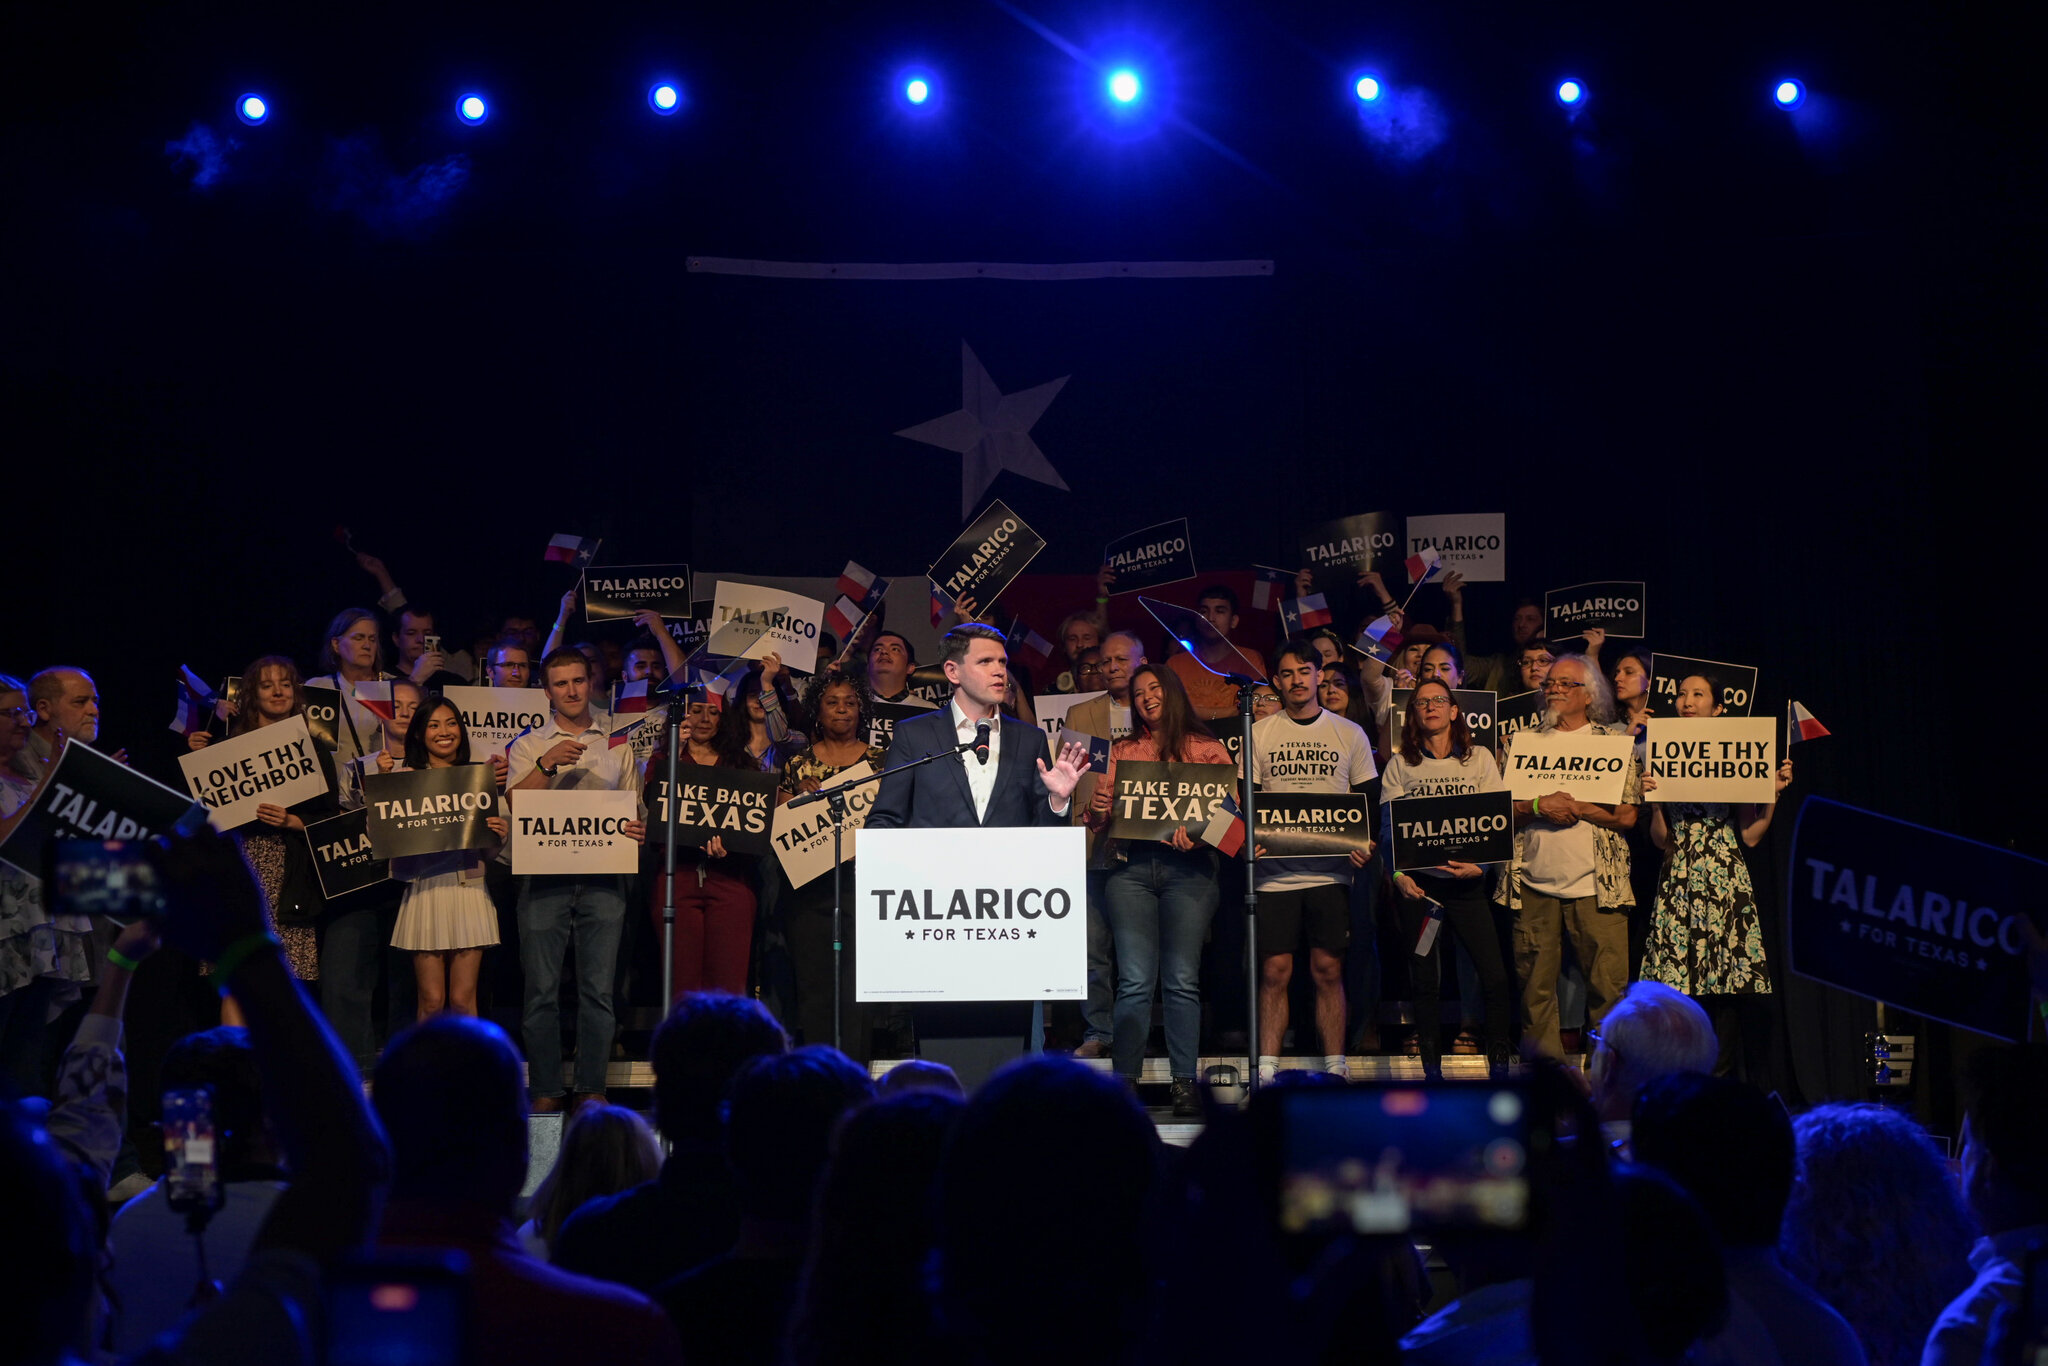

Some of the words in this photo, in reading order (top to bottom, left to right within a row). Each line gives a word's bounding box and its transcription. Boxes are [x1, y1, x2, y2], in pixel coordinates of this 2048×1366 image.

[1107, 537, 1186, 568] TALARICO
[1306, 532, 1394, 562] TALARICO
[1411, 535, 1500, 553] TALARICO
[946, 518, 1018, 593] TALARICO
[1331, 557, 1347, 566] FOR
[974, 569, 990, 584] FOR
[988, 546, 1010, 570] TEXAS
[1127, 565, 1142, 573] FOR
[1143, 558, 1167, 569] TEXAS
[589, 576, 685, 592] TALARICO
[1550, 597, 1640, 619] TALARICO
[1571, 613, 1587, 621] FOR
[718, 605, 816, 639] TALARICO
[742, 627, 761, 635] FOR
[684, 635, 700, 643] FOR
[913, 682, 955, 700] TALA
[461, 711, 545, 729] ALARICO
[1498, 712, 1541, 736] TALA
[1268, 749, 1339, 763] TALARICO
[1651, 741, 1711, 759] LOVE
[1718, 741, 1769, 759] THY
[193, 757, 256, 793] LOVE
[258, 738, 305, 769] THY
[1270, 763, 1338, 777] COUNTRY
[1514, 755, 1623, 772] TALARICO
[1650, 761, 1769, 778] NEIGHBOR
[202, 757, 316, 809] NEIGHBOR
[1121, 780, 1170, 796] TAKE
[1177, 782, 1229, 798] BACK
[374, 791, 492, 820] TALARICO
[716, 787, 768, 809] BACK
[407, 819, 428, 829] FOR
[431, 814, 465, 825] TEXAS
[657, 796, 766, 834] TEXAS
[1256, 808, 1363, 824] TALARICO
[1397, 814, 1508, 839] TALARICO
[317, 833, 372, 863] TALA
[547, 839, 567, 847] FOR
[571, 839, 604, 847] TEXAS
[810, 835, 829, 849] FOR
[1426, 839, 1446, 847] FOR
[1450, 835, 1480, 845] TEXAS
[349, 854, 369, 866] FOR
[870, 887, 1071, 921] TALARICO
[923, 928, 956, 940] FOR
[963, 928, 1020, 940] TEXAS
[1858, 921, 1897, 949] FOR
[1904, 936, 1970, 969] TEXAS
